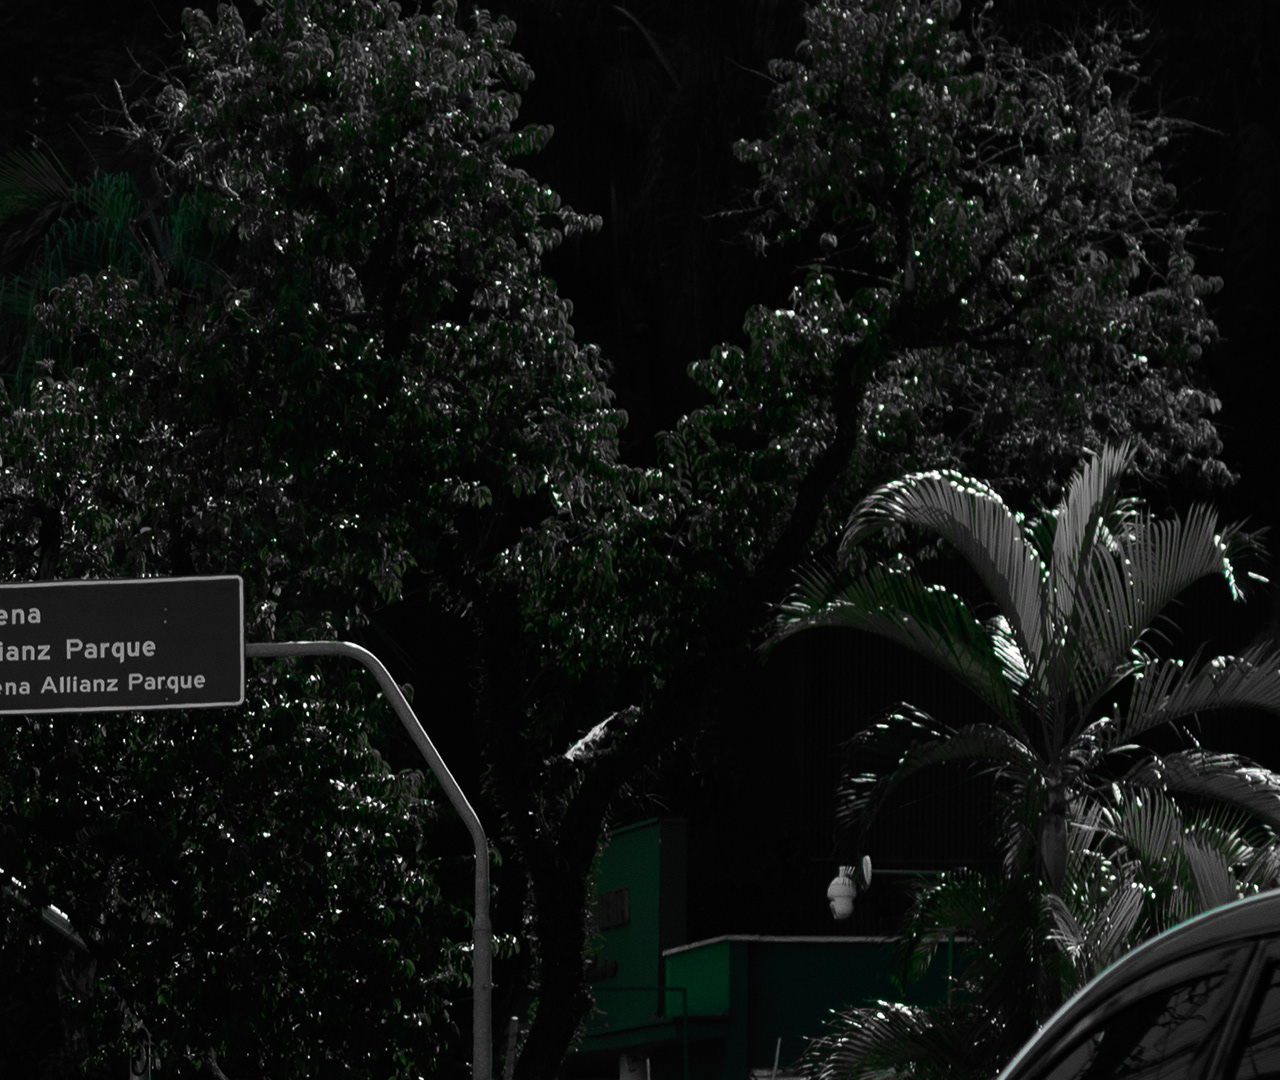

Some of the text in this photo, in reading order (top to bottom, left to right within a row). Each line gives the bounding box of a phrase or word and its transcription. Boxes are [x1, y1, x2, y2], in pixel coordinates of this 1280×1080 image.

[67, 639, 156, 663] Parque
[41, 676, 118, 693] Allianz
[129, 673, 206, 693] Parque
